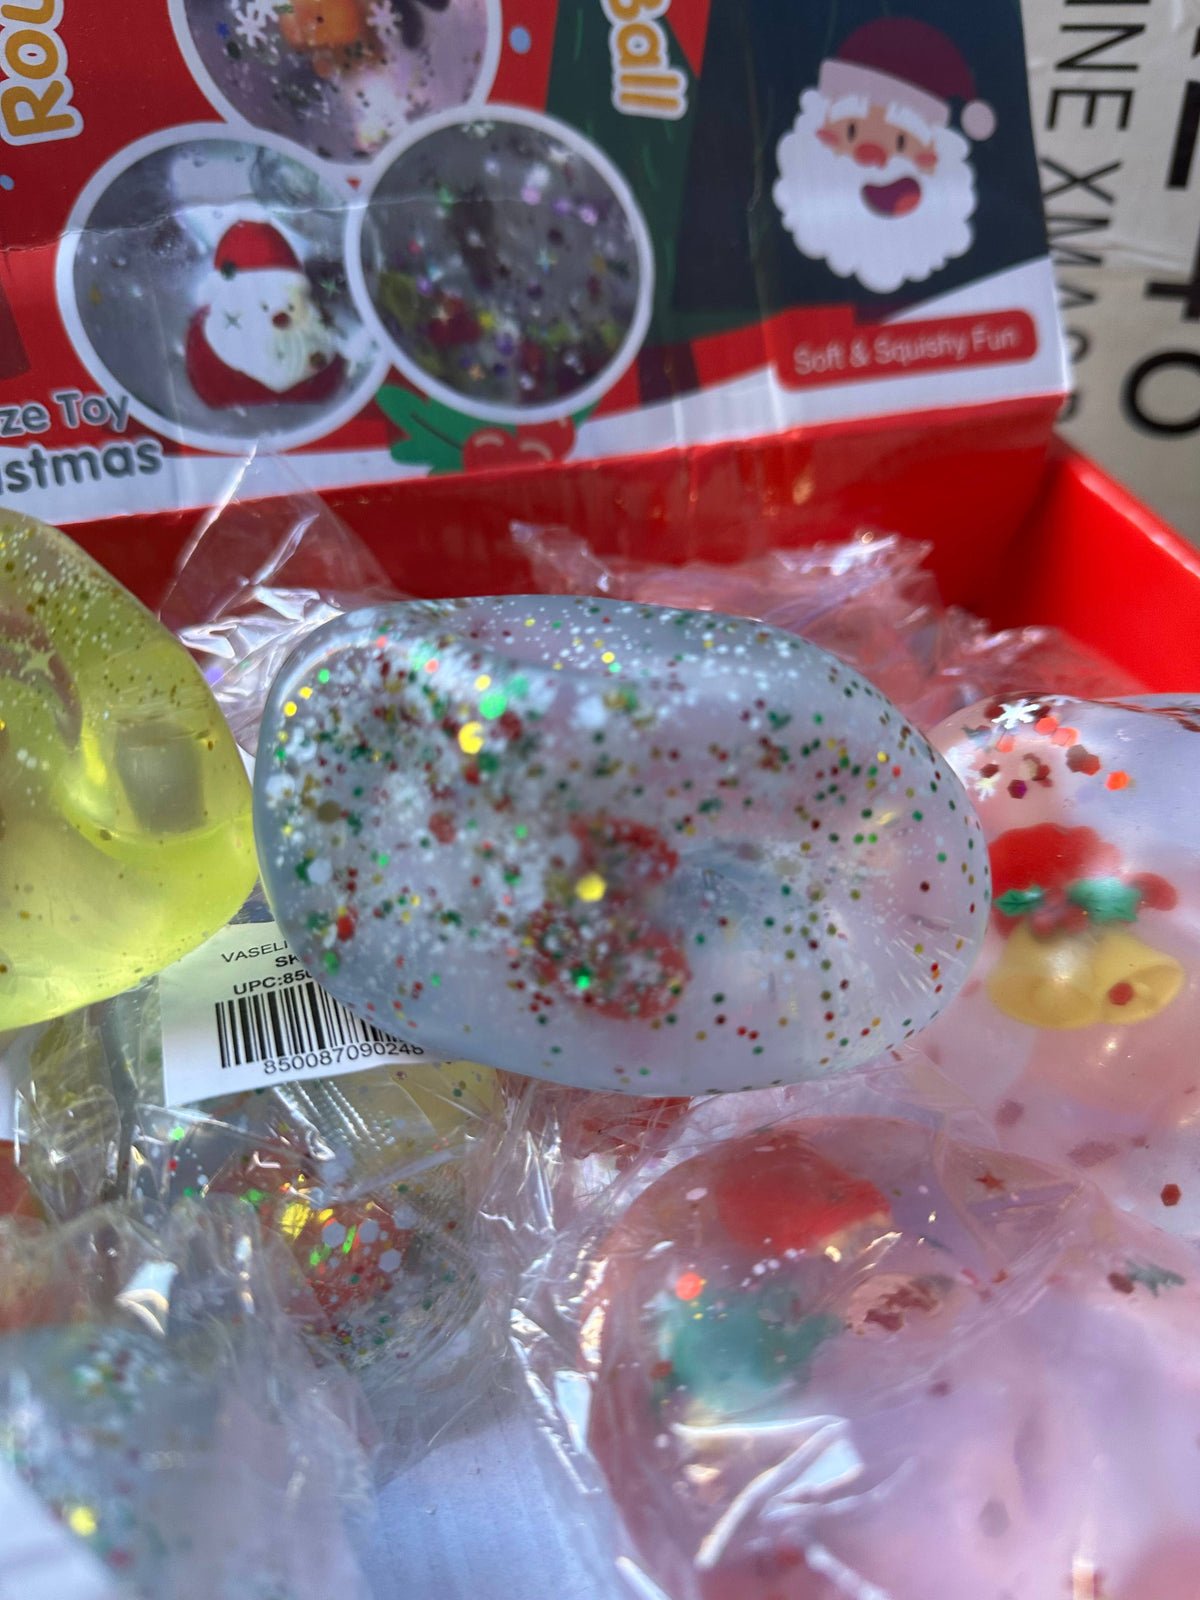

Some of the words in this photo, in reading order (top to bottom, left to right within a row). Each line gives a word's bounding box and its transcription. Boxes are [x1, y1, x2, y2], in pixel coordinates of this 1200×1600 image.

[793, 341, 845, 375] Soft
[850, 337, 869, 367] &
[874, 331, 968, 367] Squishy
[971, 324, 1017, 351] Fun
[54, 391, 129, 431] Toy
